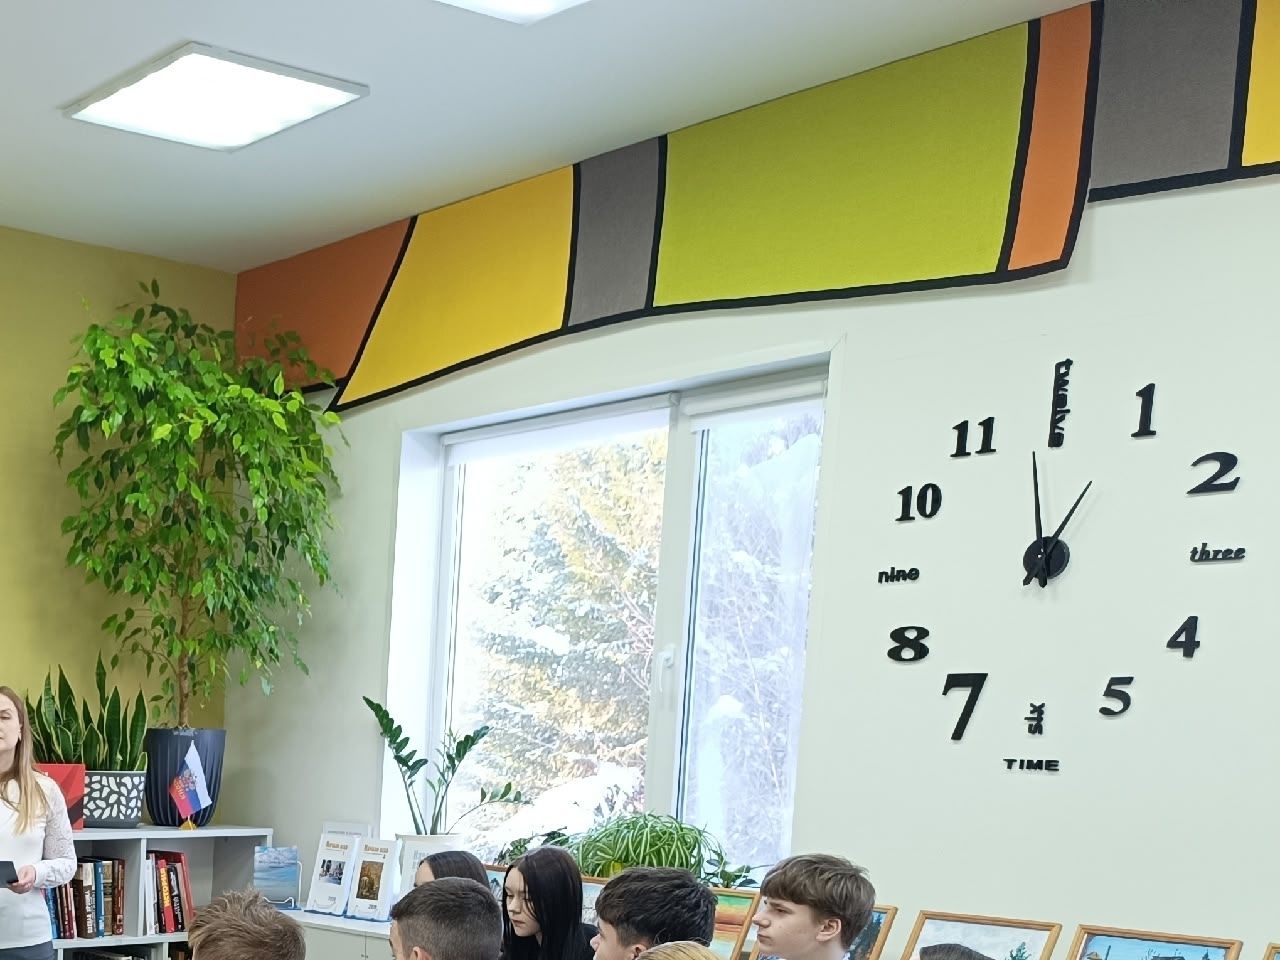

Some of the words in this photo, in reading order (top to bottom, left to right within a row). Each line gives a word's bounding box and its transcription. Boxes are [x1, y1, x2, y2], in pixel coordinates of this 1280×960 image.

[1048, 358, 1074, 449] twelve
[1130, 383, 1157, 438] 1
[950, 416, 997, 458] 11
[1186, 452, 1241, 495] 2
[896, 483, 943, 522] 10
[1189, 542, 1246, 563] three
[878, 567, 920, 584] nine
[887, 626, 930, 662] 8
[1166, 616, 1201, 659] 4
[942, 673, 989, 741] 7
[1099, 676, 1135, 716] 5
[1025, 703, 1046, 736] six
[1003, 759, 1060, 772] TIME
[160, 867, 171, 908] ИСТОРИЯ
